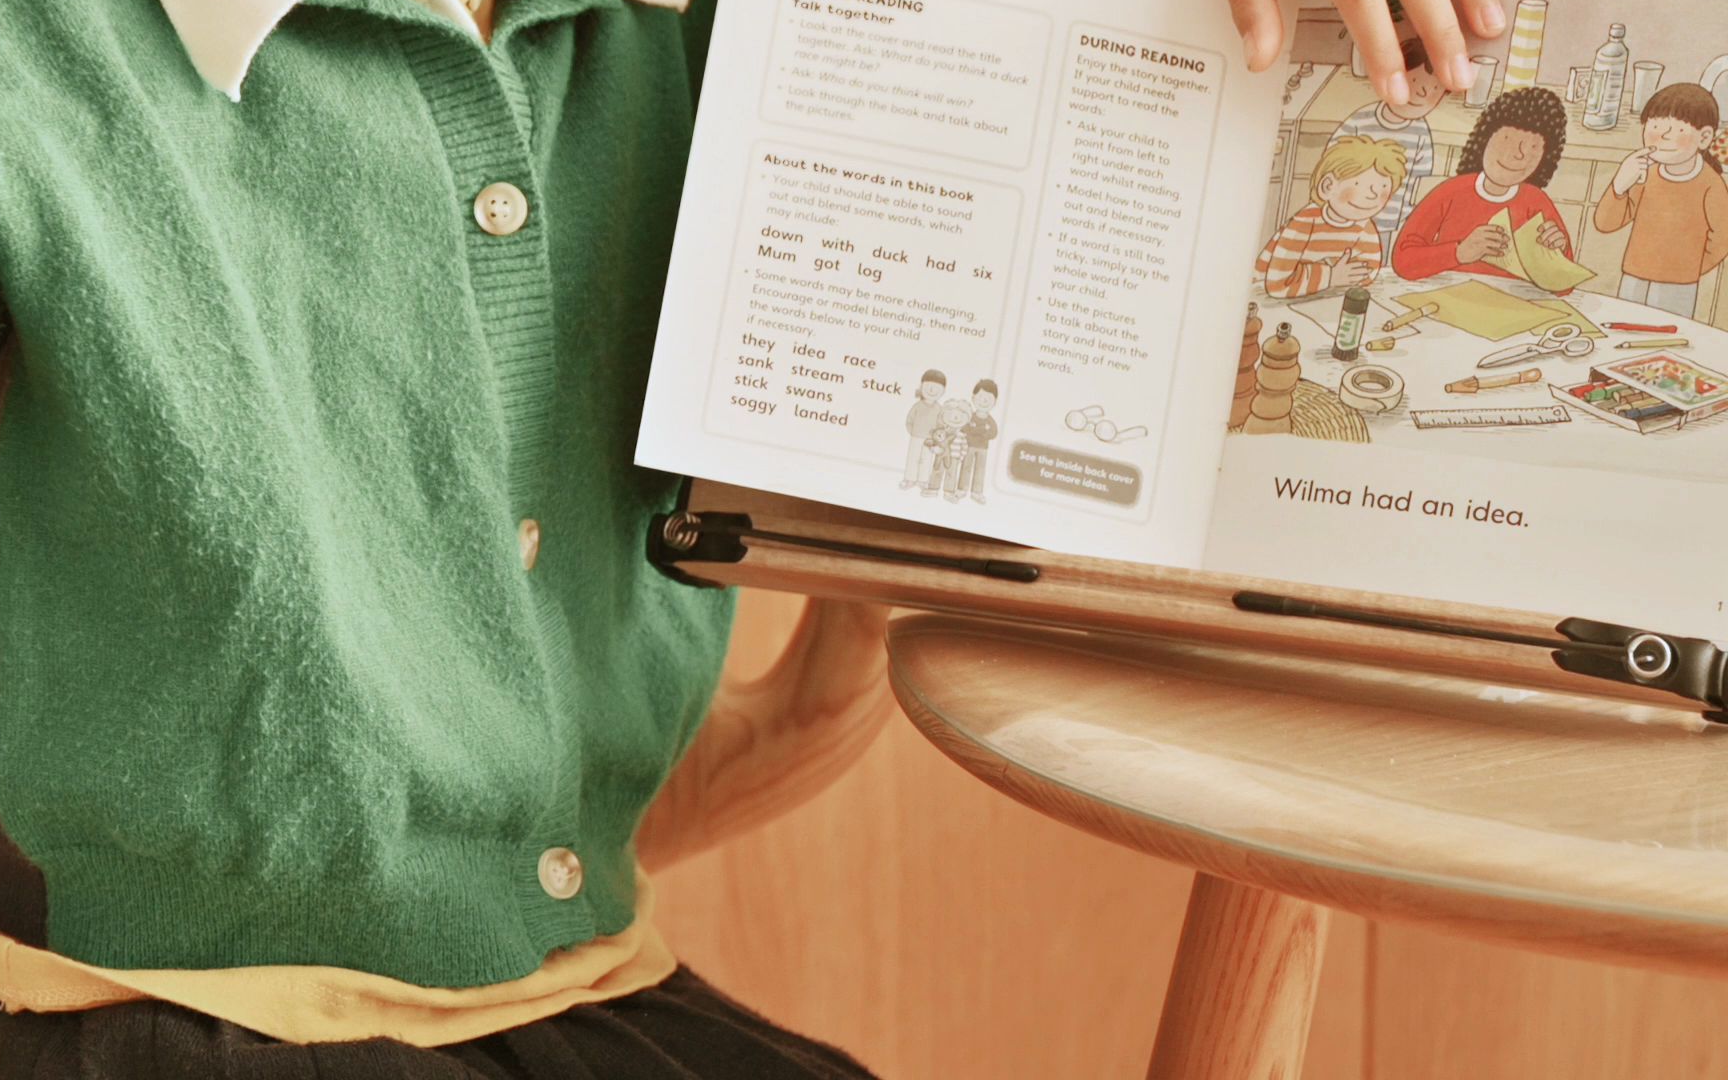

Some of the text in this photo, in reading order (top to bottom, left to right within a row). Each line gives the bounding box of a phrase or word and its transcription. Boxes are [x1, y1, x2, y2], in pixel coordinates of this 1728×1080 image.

[827, 4, 895, 25] together
[800, 18, 1003, 65] Look at the cover and read the title
[1080, 34, 1206, 73] DURING READING
[1077, 53, 1107, 73] Enjoy
[1110, 62, 1128, 75] the
[1131, 68, 1159, 84] story
[1074, 68, 1176, 102] If your child needs
[788, 84, 1009, 136] Look through the book and talk about
[1072, 86, 1180, 118] support to read the
[1077, 120, 1170, 150] Ask your child to
[1072, 152, 1164, 180] right under each
[1074, 137, 1171, 166] point from left to
[764, 153, 974, 202] About the words in this book
[1070, 167, 1100, 181] word
[1101, 173, 1135, 189] whilst
[773, 174, 973, 221] Your child should be able to sound
[1066, 183, 1182, 219] Model how to sound
[1062, 215, 1096, 231] words
[1098, 221, 1108, 233] if
[1064, 200, 1170, 232] out and blend new
[758, 244, 883, 283] Mum got log
[761, 225, 993, 280] down with duck had six
[1058, 231, 1165, 266] If a word is still too
[1053, 264, 1139, 291] whole word for
[1092, 256, 1128, 275] simply
[1130, 266, 1149, 280] say
[1152, 269, 1170, 283] the
[755, 268, 787, 284] Some
[789, 277, 825, 292] words
[827, 284, 854, 300] may
[856, 287, 871, 301] be
[874, 293, 905, 307] more
[749, 299, 921, 341] the words below to your child
[752, 283, 814, 307] Encourage
[816, 297, 830, 307] or
[832, 300, 869, 316] model
[930, 318, 956, 332] then
[959, 325, 987, 338] read
[1048, 296, 1136, 326] Use the pictures
[1045, 312, 1140, 342] to talk about the
[742, 332, 877, 370] they idea race
[1040, 344, 1131, 372] meaning of new
[1043, 328, 1149, 359] story and learn the
[735, 374, 833, 403] stick swans
[738, 355, 902, 396] sank stream stuck
[731, 395, 849, 426] soggy landed
[1020, 450, 1134, 484] See the inside back cover
[1040, 467, 1055, 479] for
[1056, 473, 1081, 485] more
[1275, 476, 1529, 528] Wilma had an idea.
